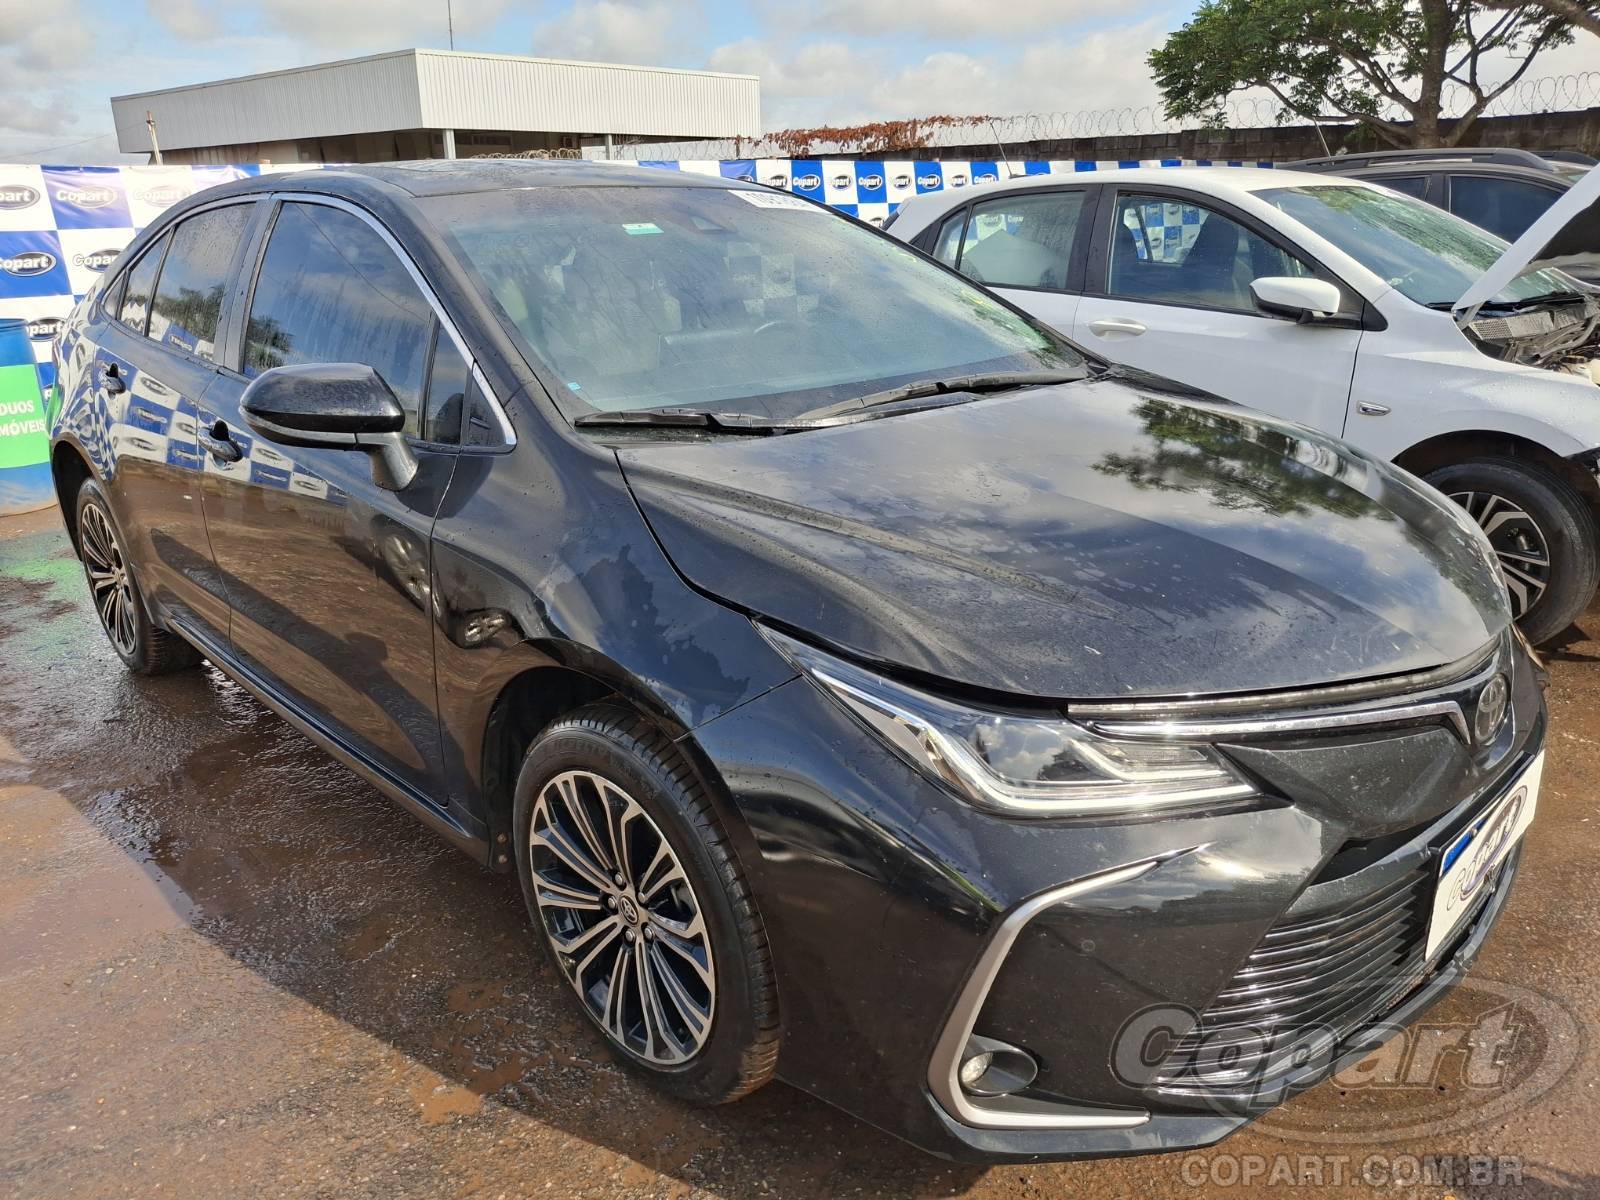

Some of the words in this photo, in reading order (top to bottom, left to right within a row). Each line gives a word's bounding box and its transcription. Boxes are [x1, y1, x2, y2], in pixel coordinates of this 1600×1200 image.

[793, 177, 818, 188] Copart
[858, 177, 881, 188] Copart
[917, 177, 939, 188] Copart
[56, 190, 110, 204] Copart
